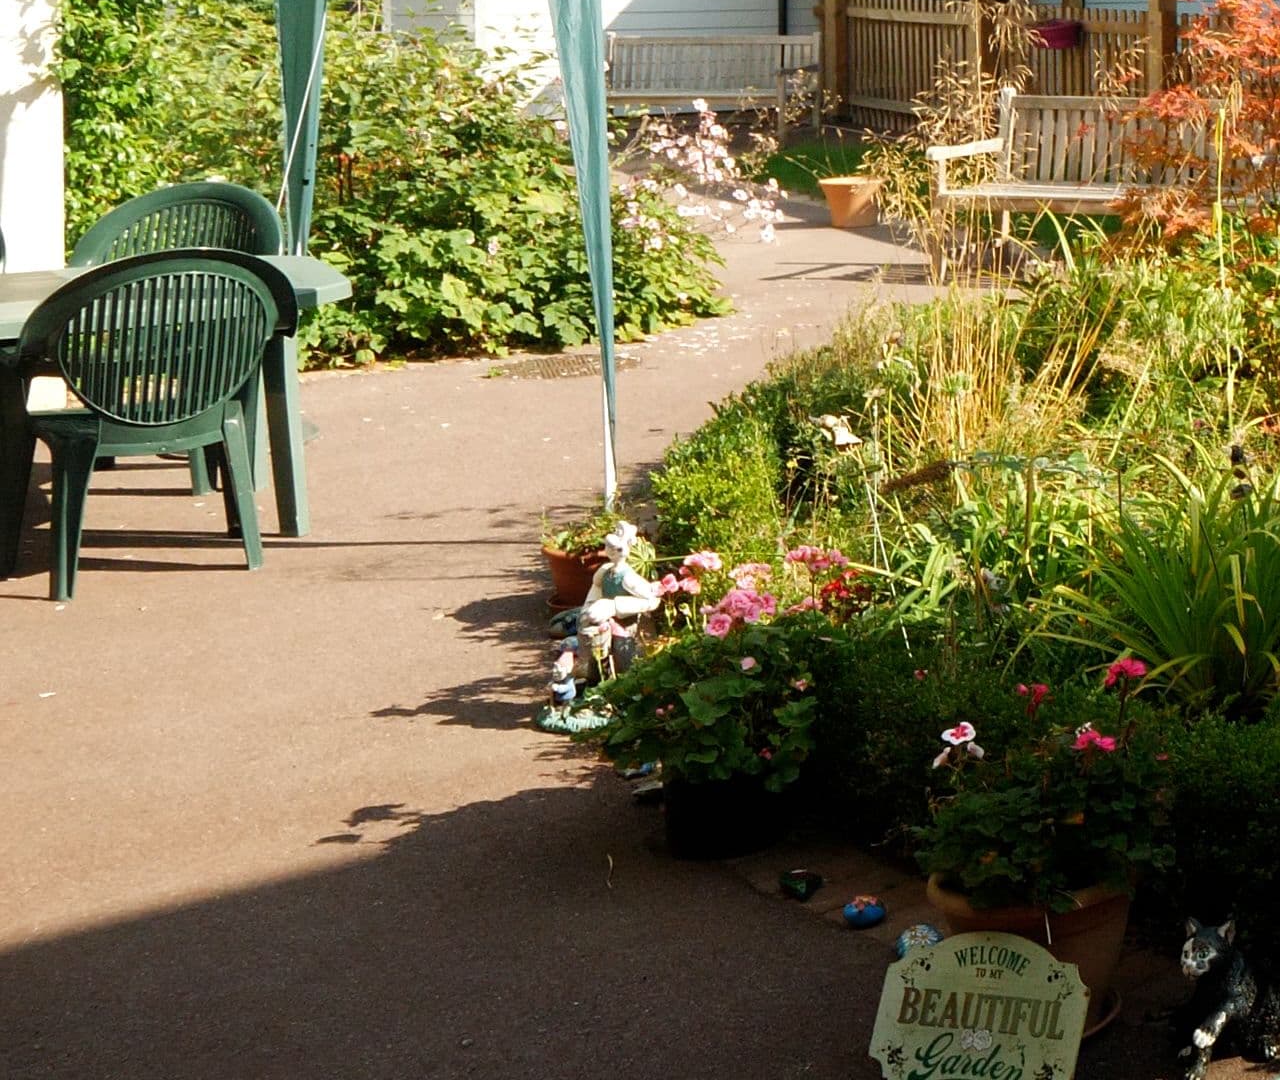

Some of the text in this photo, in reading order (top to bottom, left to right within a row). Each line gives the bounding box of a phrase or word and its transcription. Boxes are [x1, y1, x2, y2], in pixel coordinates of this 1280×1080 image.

[954, 945, 1031, 977] WELCOME
[975, 967, 1004, 980] TO MY
[896, 986, 1065, 1040] BEAUTIFUL
[908, 1032, 1023, 1080] Garden
